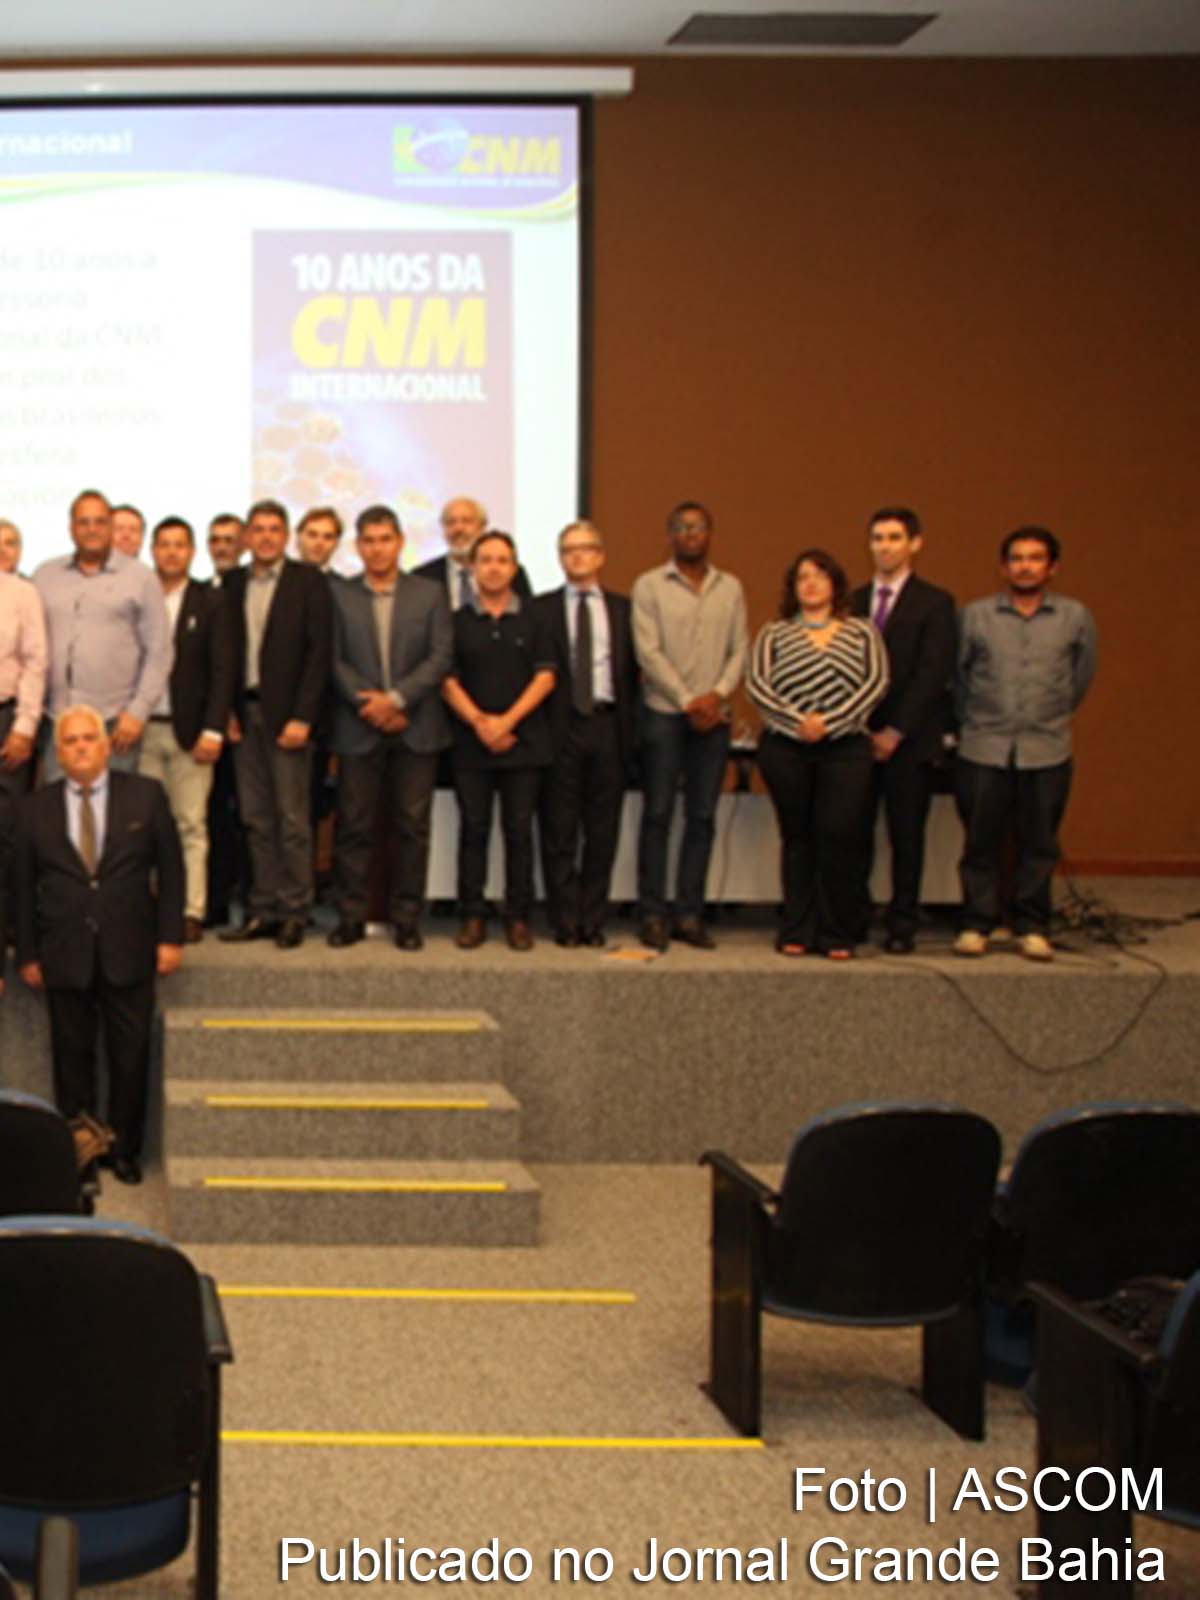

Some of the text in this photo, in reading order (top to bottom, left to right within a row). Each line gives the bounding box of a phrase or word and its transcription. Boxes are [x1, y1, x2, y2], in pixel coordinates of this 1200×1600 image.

[459, 135, 561, 174] CNM
[291, 252, 485, 292] 10 ANOS DA
[290, 292, 488, 369] CNM
[289, 372, 488, 401] INTERNACIONAL
